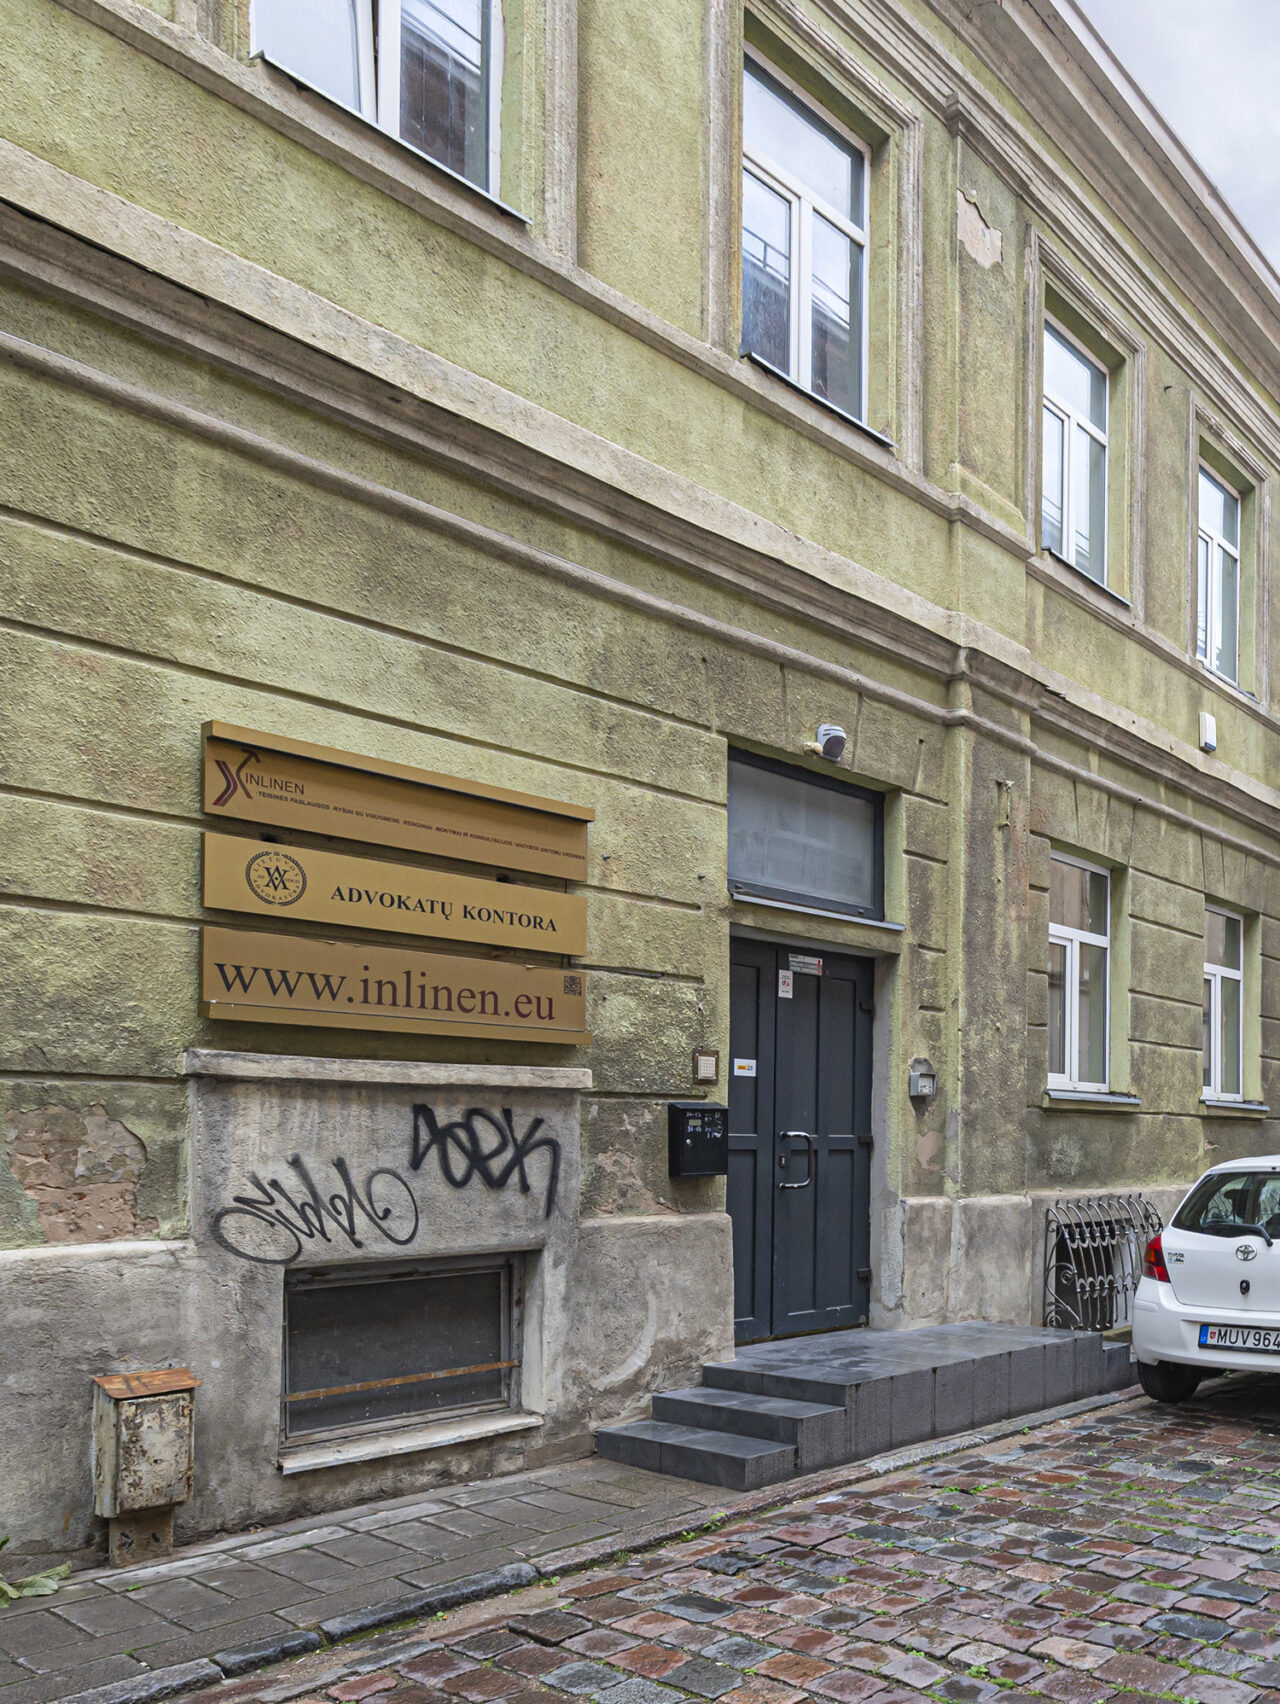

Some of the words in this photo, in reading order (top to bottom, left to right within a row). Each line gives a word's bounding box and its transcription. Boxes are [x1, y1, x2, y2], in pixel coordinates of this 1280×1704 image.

[245, 772, 305, 795] INLINEN
[330, 885, 453, 920] ADVOKATŲ
[463, 904, 557, 932] KONTORA
[213, 963, 556, 1021] www.inlinen.eu
